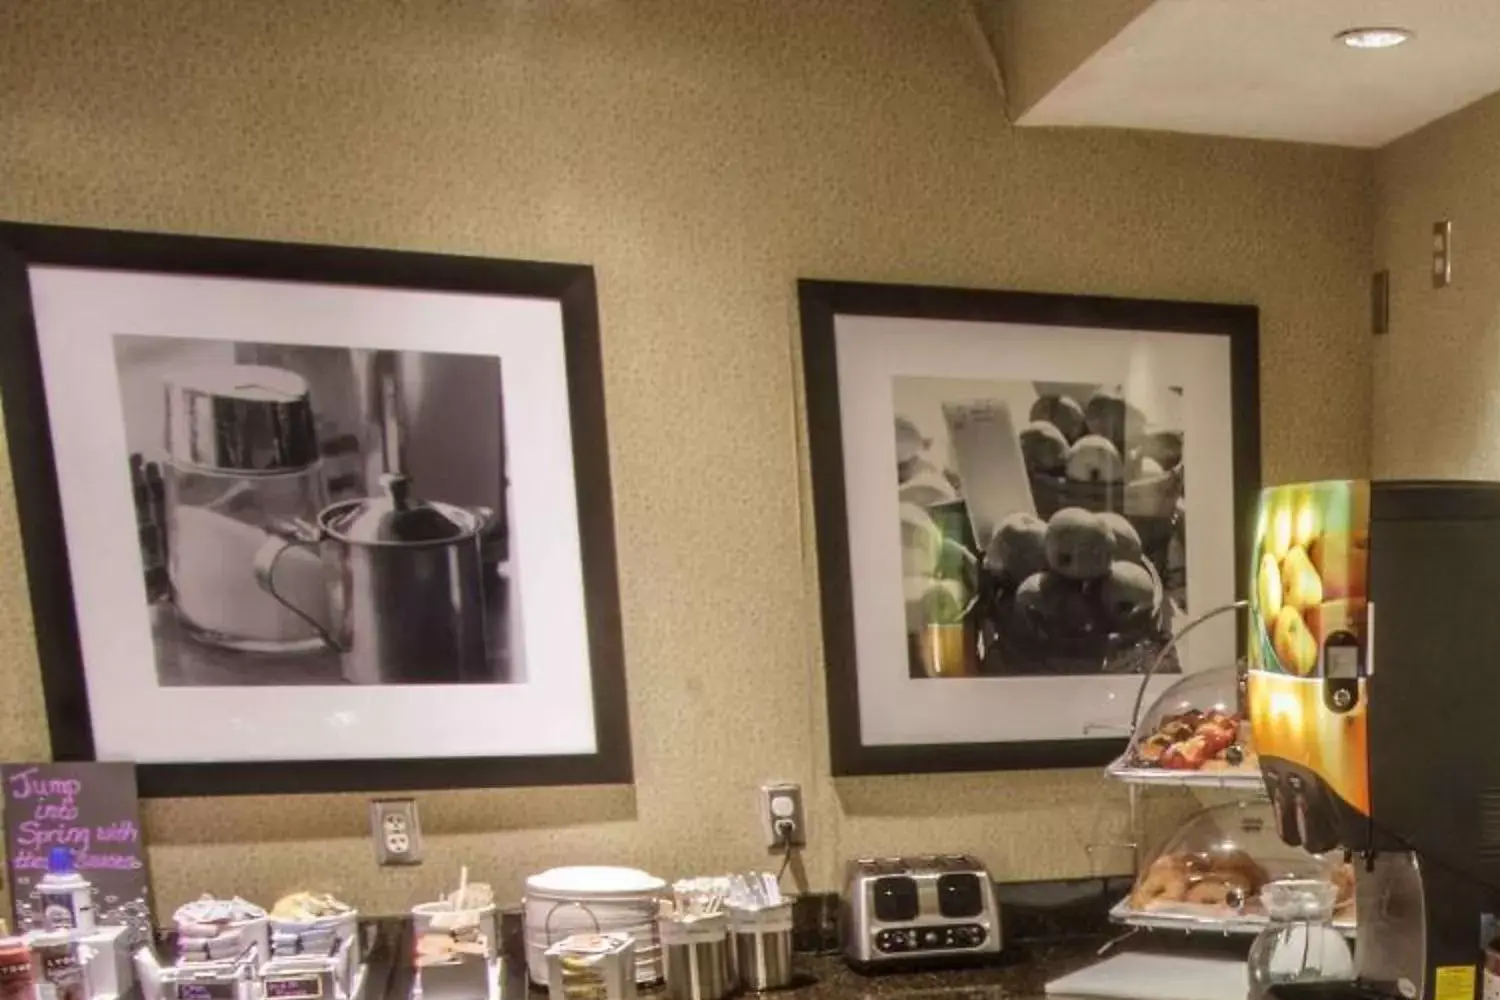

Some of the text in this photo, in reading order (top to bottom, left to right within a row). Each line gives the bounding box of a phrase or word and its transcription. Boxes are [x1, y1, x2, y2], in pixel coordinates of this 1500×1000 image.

[9, 767, 81, 806] Jump
[34, 796, 79, 820] into
[17, 820, 138, 860] Spring with
